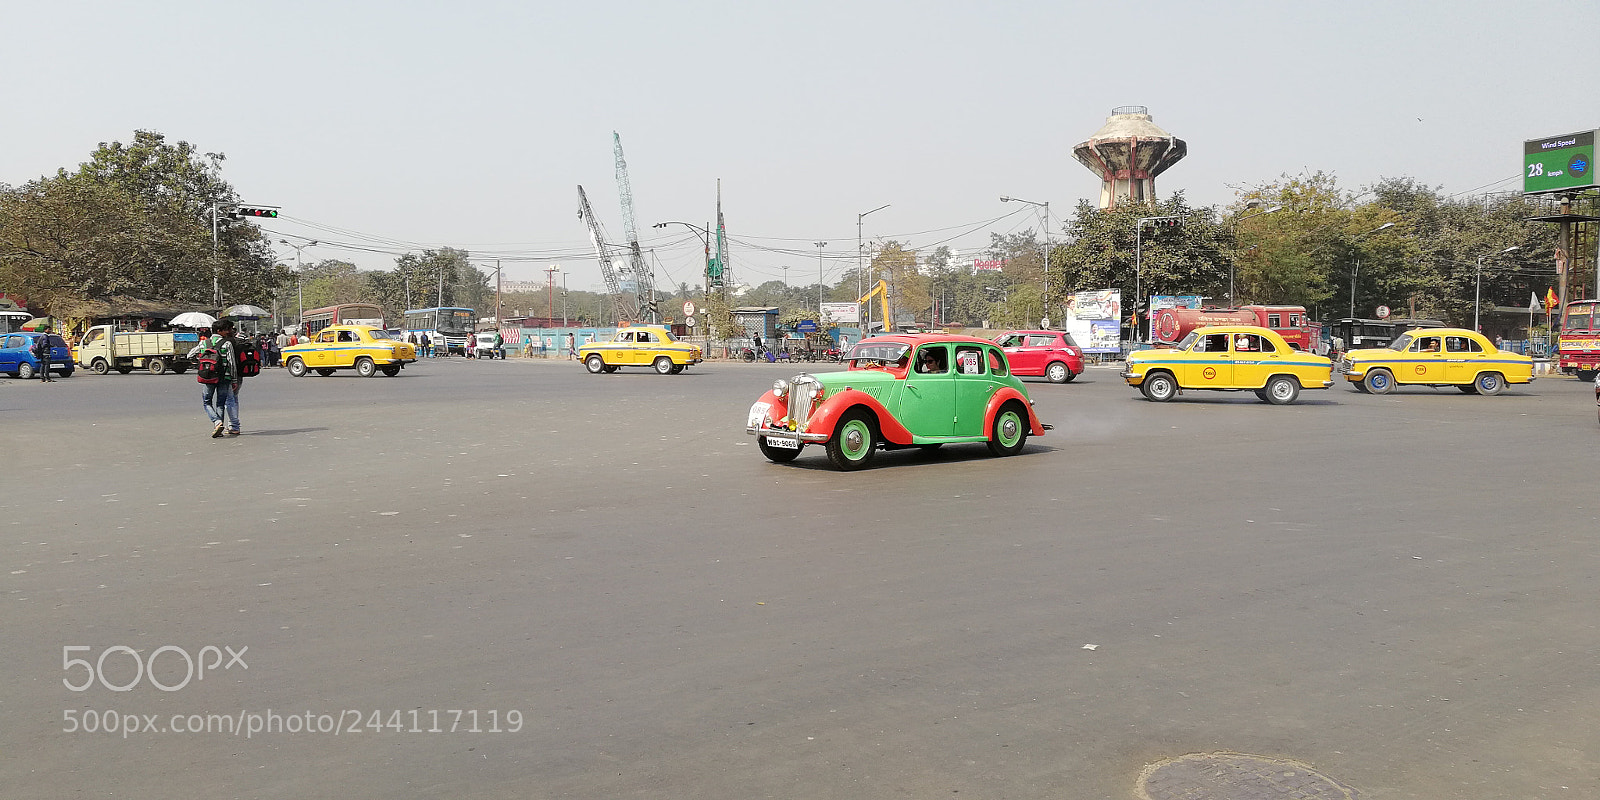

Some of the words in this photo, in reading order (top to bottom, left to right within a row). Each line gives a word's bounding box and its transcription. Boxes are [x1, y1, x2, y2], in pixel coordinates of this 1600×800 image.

[1541, 141, 1557, 149] Wind
[1557, 138, 1576, 148] Speed
[1527, 162, 1543, 178] 28
[1547, 169, 1564, 177] kmph
[964, 358, 977, 366] 085
[752, 405, 767, 415] 085
